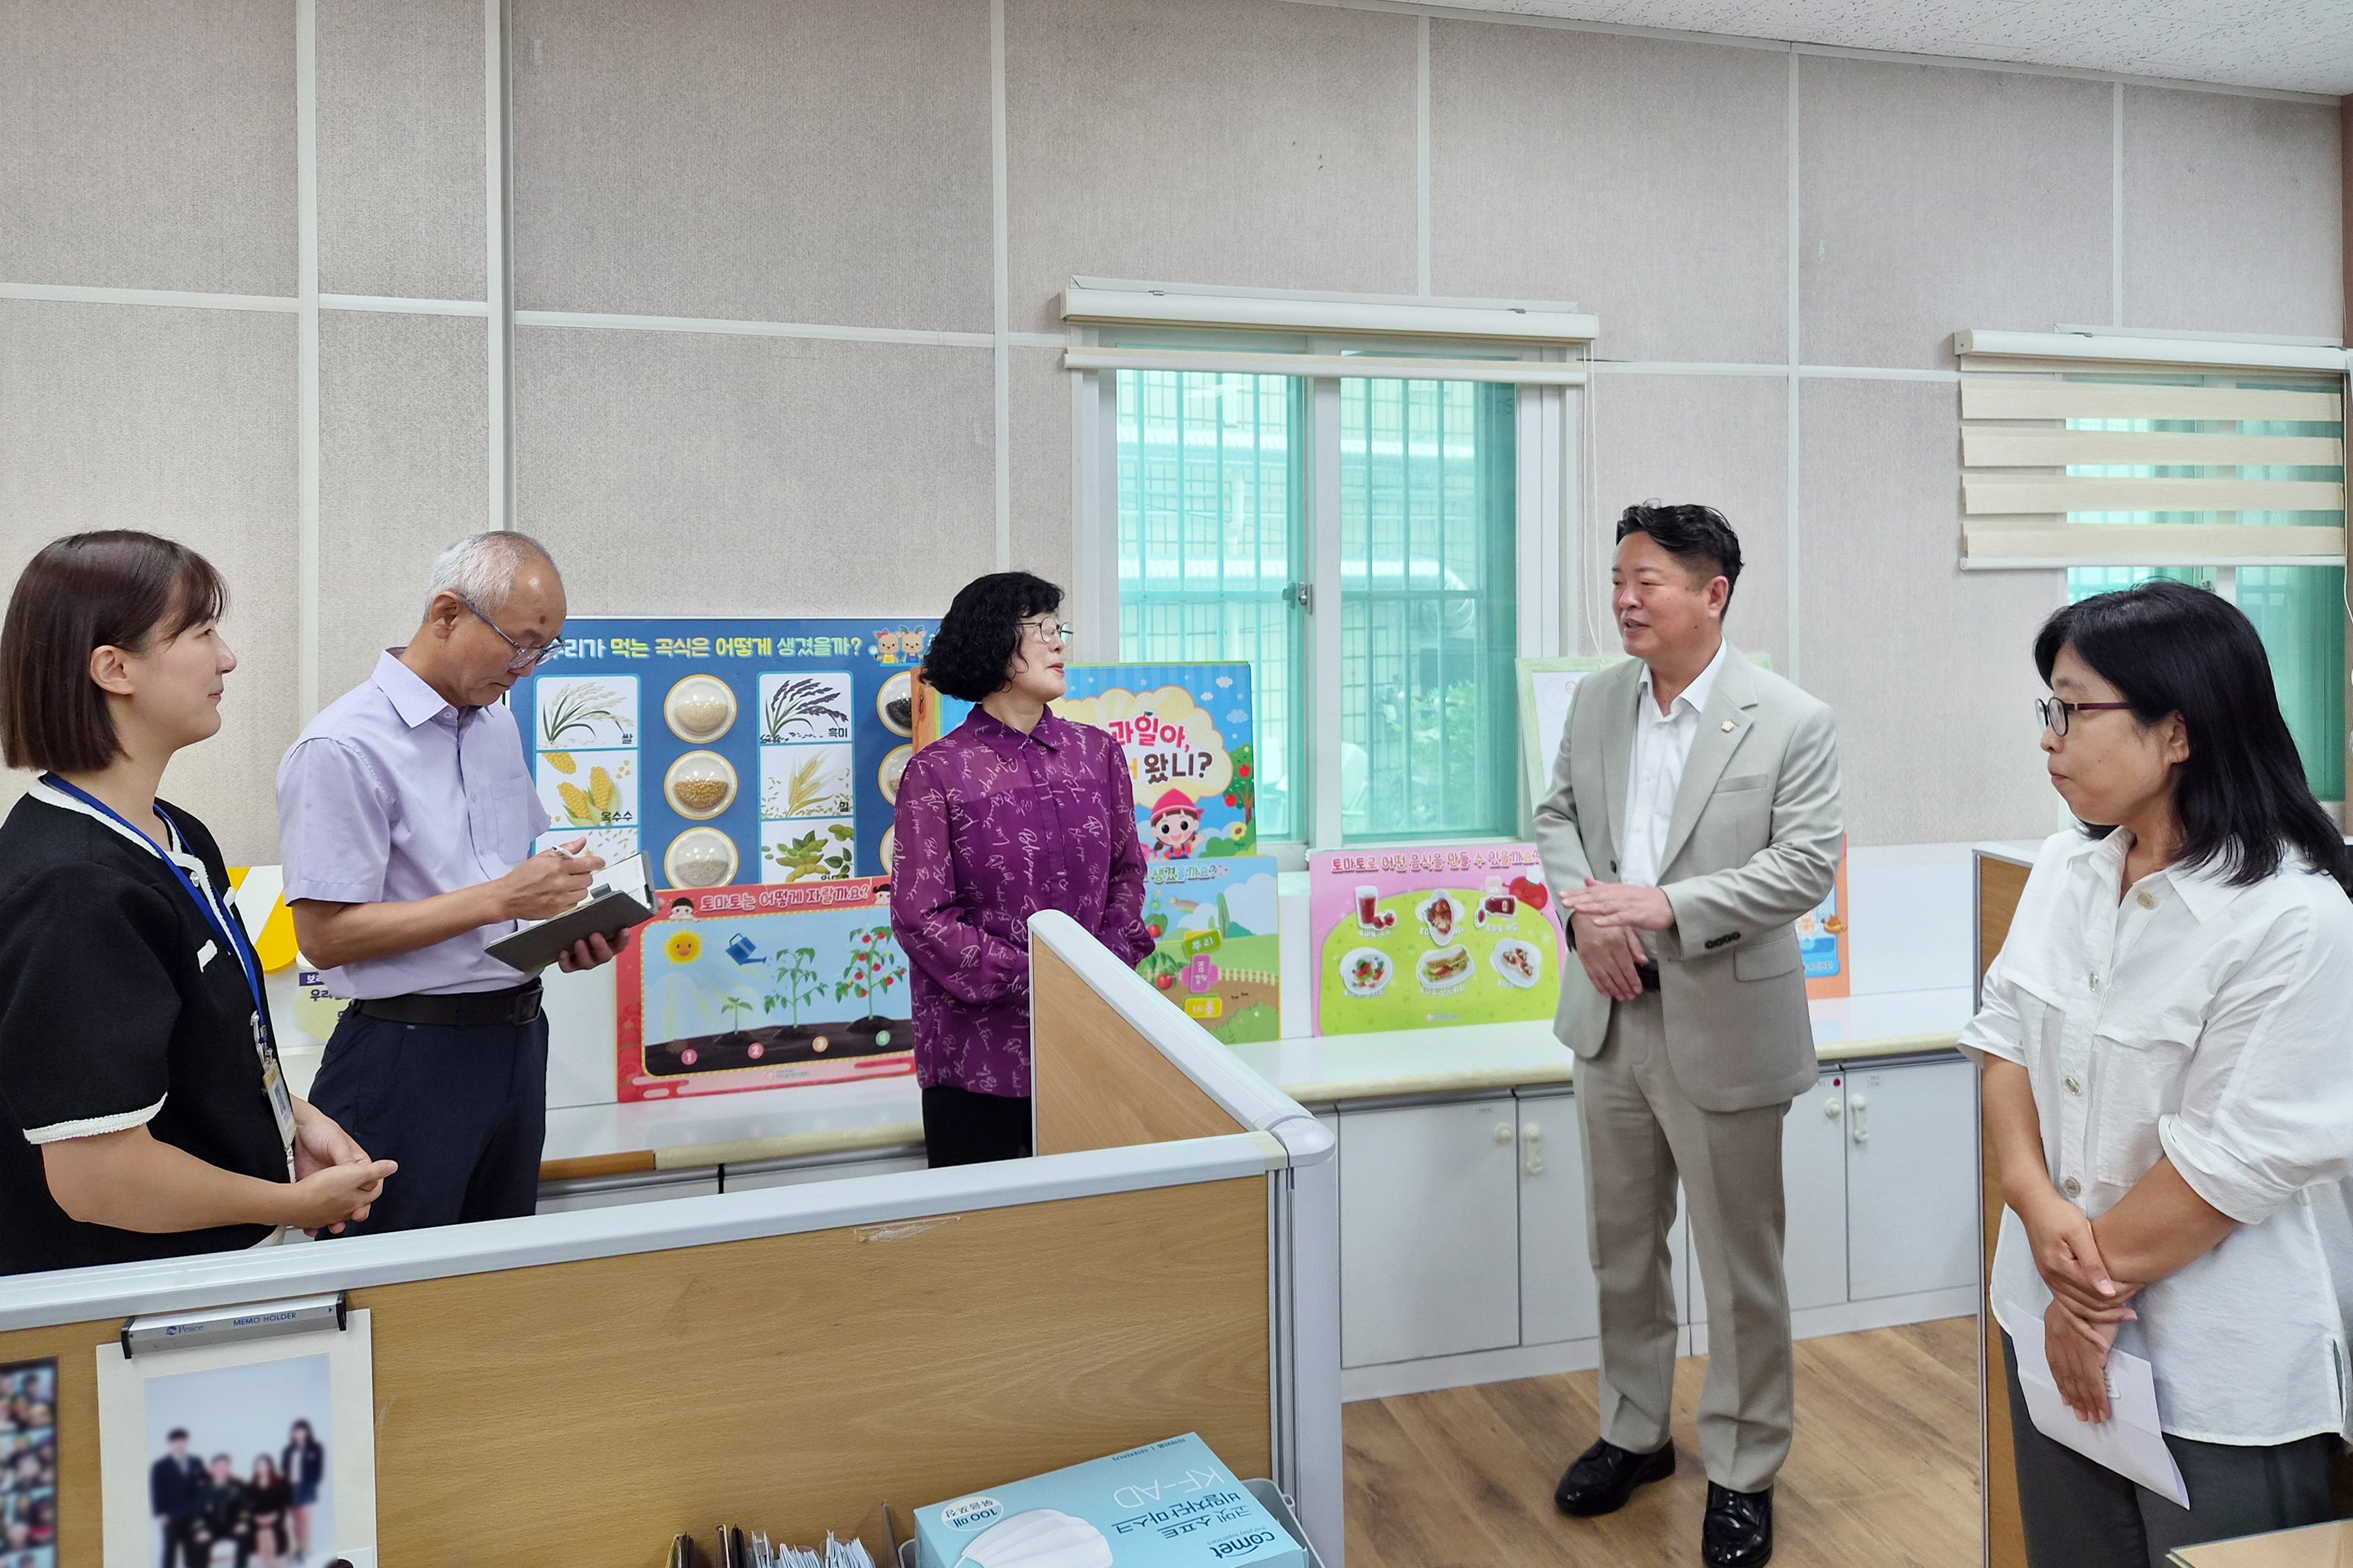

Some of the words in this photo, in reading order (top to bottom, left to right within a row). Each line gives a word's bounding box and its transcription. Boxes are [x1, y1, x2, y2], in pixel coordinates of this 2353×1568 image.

[610, 638, 650, 659] 먹는
[655, 637, 710, 659] 곡식은
[715, 637, 772, 658] 어떻게
[776, 636, 862, 658] 생겼을까?
[621, 732, 633, 744] 쌀
[827, 727, 848, 739] 흑미
[1109, 715, 1190, 752] 과일아,
[1144, 752, 1213, 784] 왔니?
[601, 811, 633, 823] 옥수수
[1331, 858, 1378, 873] 토마토로
[1381, 856, 1407, 871] 어떤
[1410, 852, 1444, 871] 음식을
[1447, 852, 1470, 869] 만들
[1473, 852, 1486, 867] 수
[1488, 850, 1539, 867] 있을까요?
[1152, 864, 1218, 884] 생겼을까요?
[700, 895, 756, 912] 토마토는
[759, 890, 803, 909] 어떻게
[805, 886, 870, 905] 자랄까요?
[1192, 936, 1214, 951] 뿌리
[686, 1051, 693, 1062] 1
[752, 1045, 760, 1056] 2
[178, 1324, 203, 1334] Peace
[233, 1316, 260, 1326] MEMO
[263, 1312, 297, 1322] HOLDER
[1112, 1466, 1226, 1508] KF-AD
[1168, 1492, 1241, 1517] 비말차단
[1212, 1505, 1252, 1524] 코멧
[1111, 1511, 1167, 1535] 마스크
[1156, 1515, 1210, 1540] 소프트
[1210, 1531, 1275, 1560] comet
